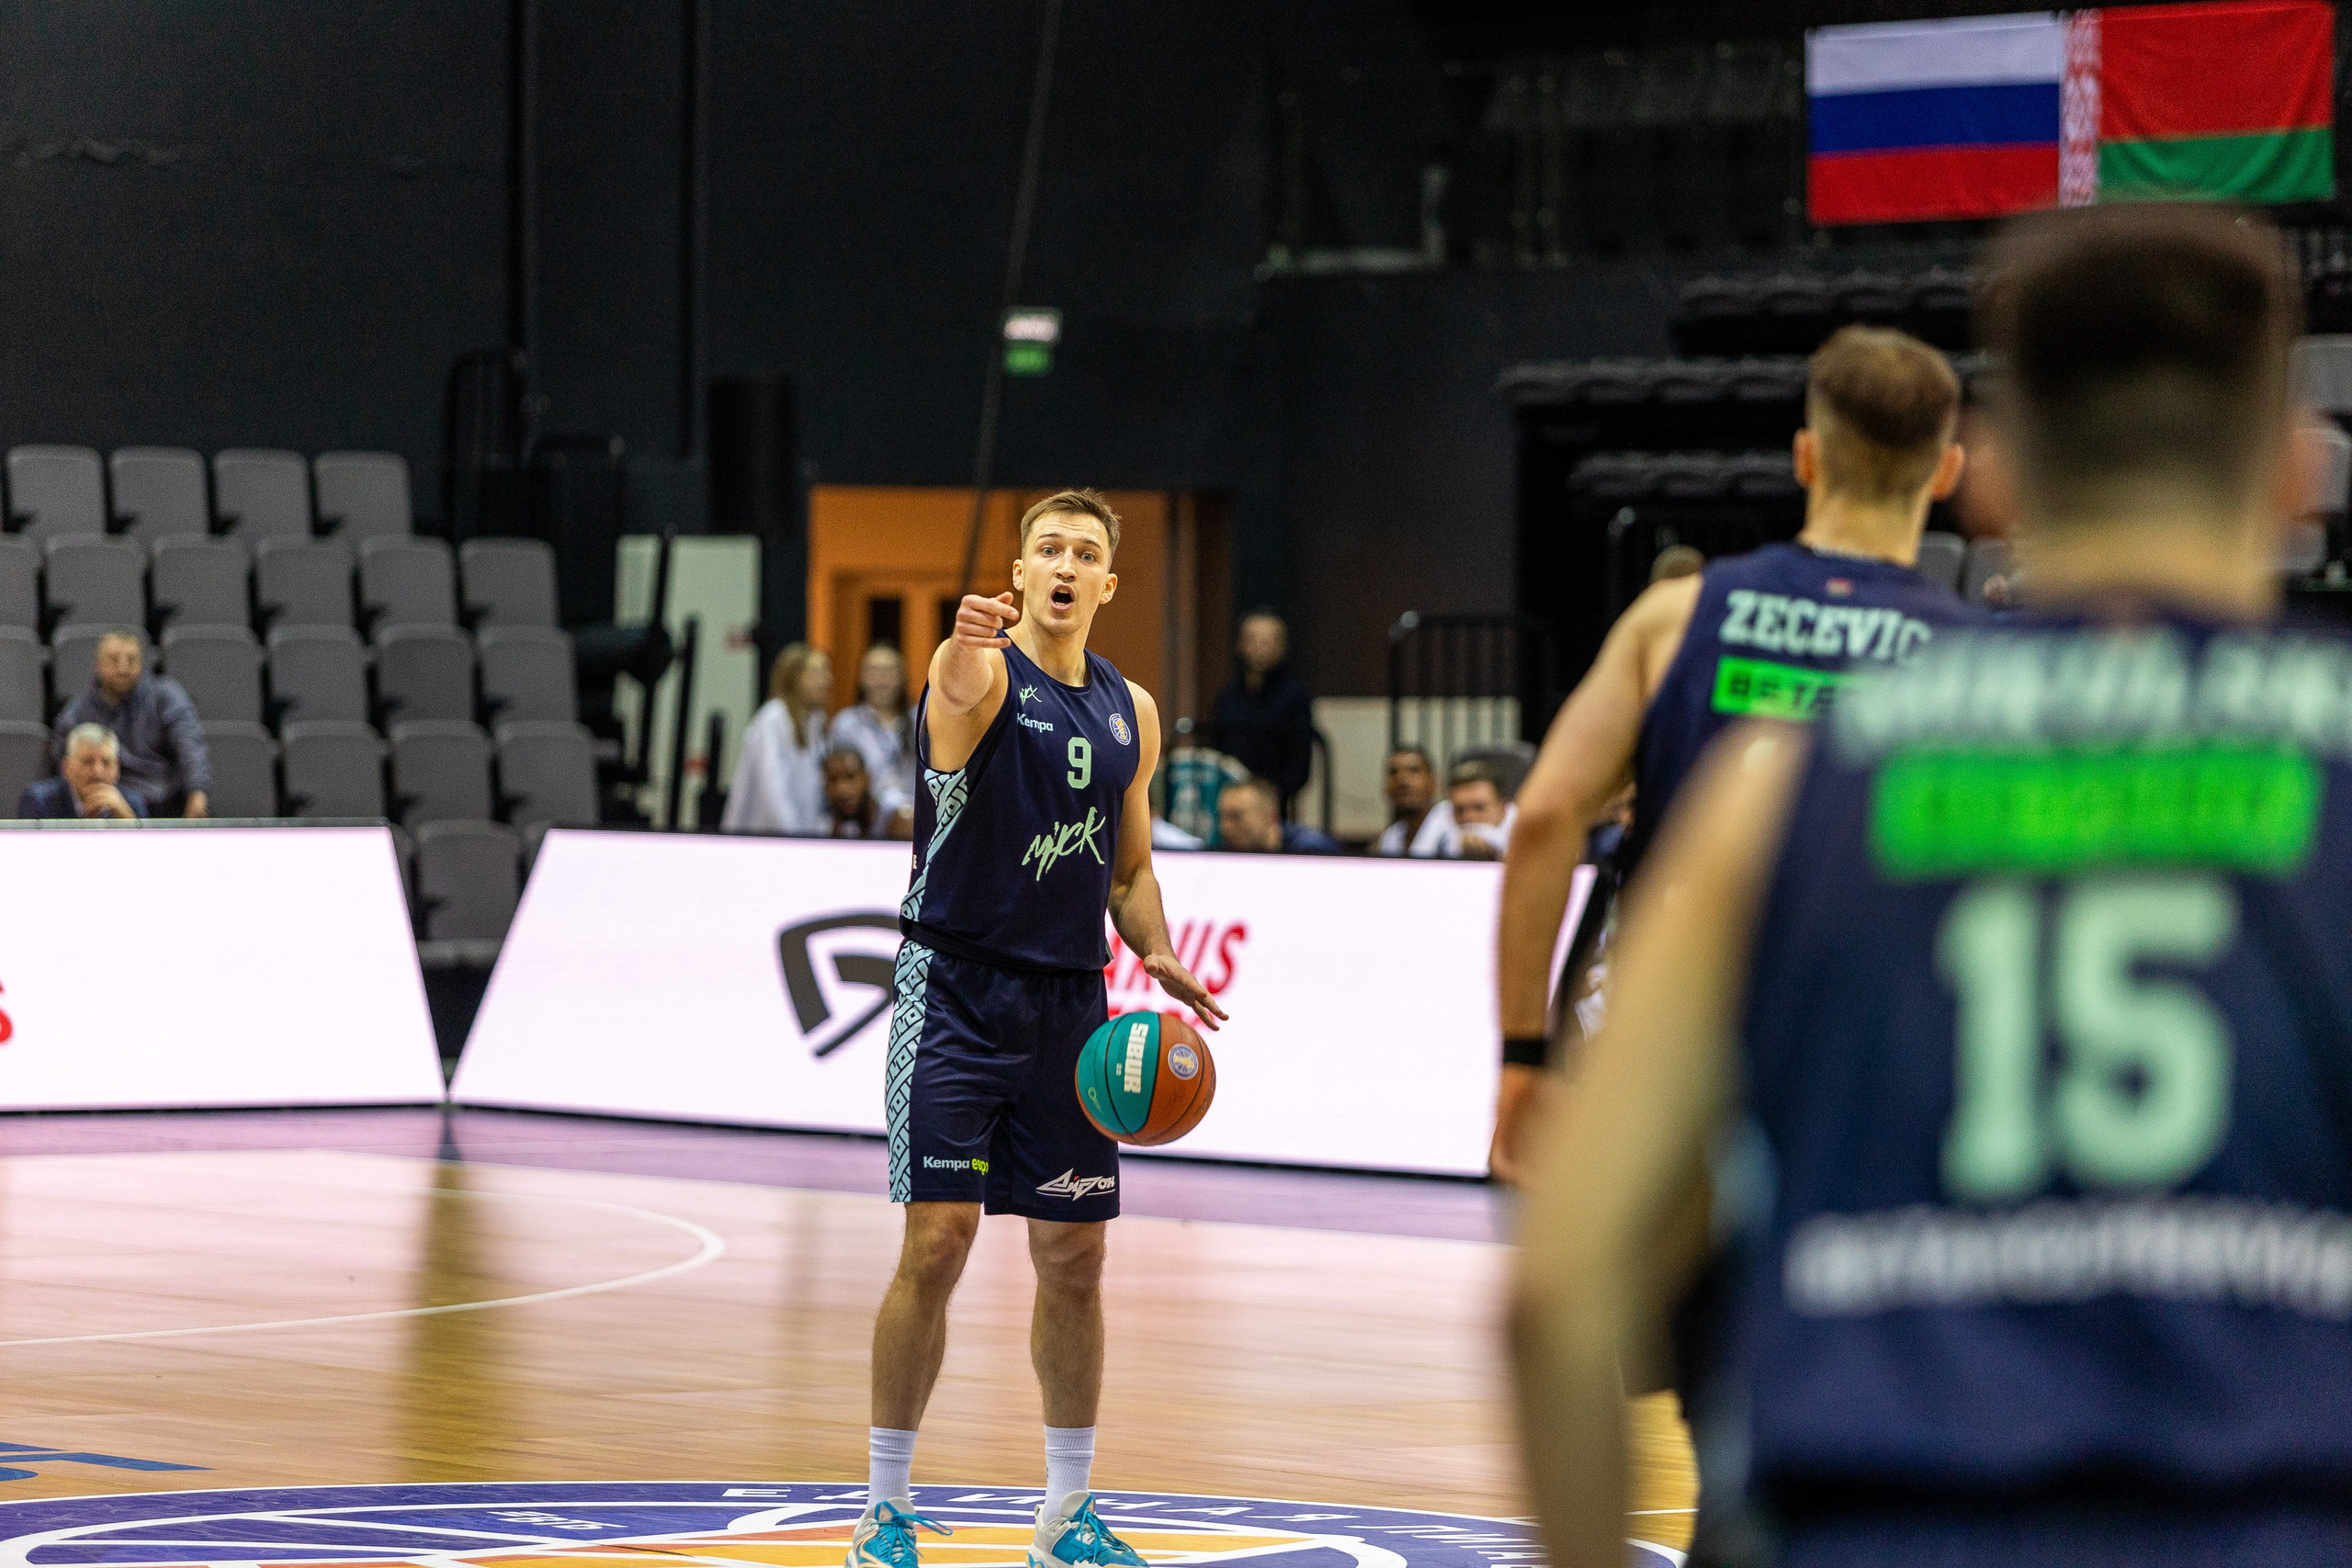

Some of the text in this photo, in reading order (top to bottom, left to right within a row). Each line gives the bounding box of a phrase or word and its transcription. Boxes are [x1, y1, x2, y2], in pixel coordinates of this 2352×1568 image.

[1017, 713, 1054, 733] Kempa
[1067, 737, 1091, 789] 9
[1124, 1022, 1149, 1093] SIBUR
[1934, 877, 2239, 1201] 15
[923, 1156, 970, 1172] Kempa
